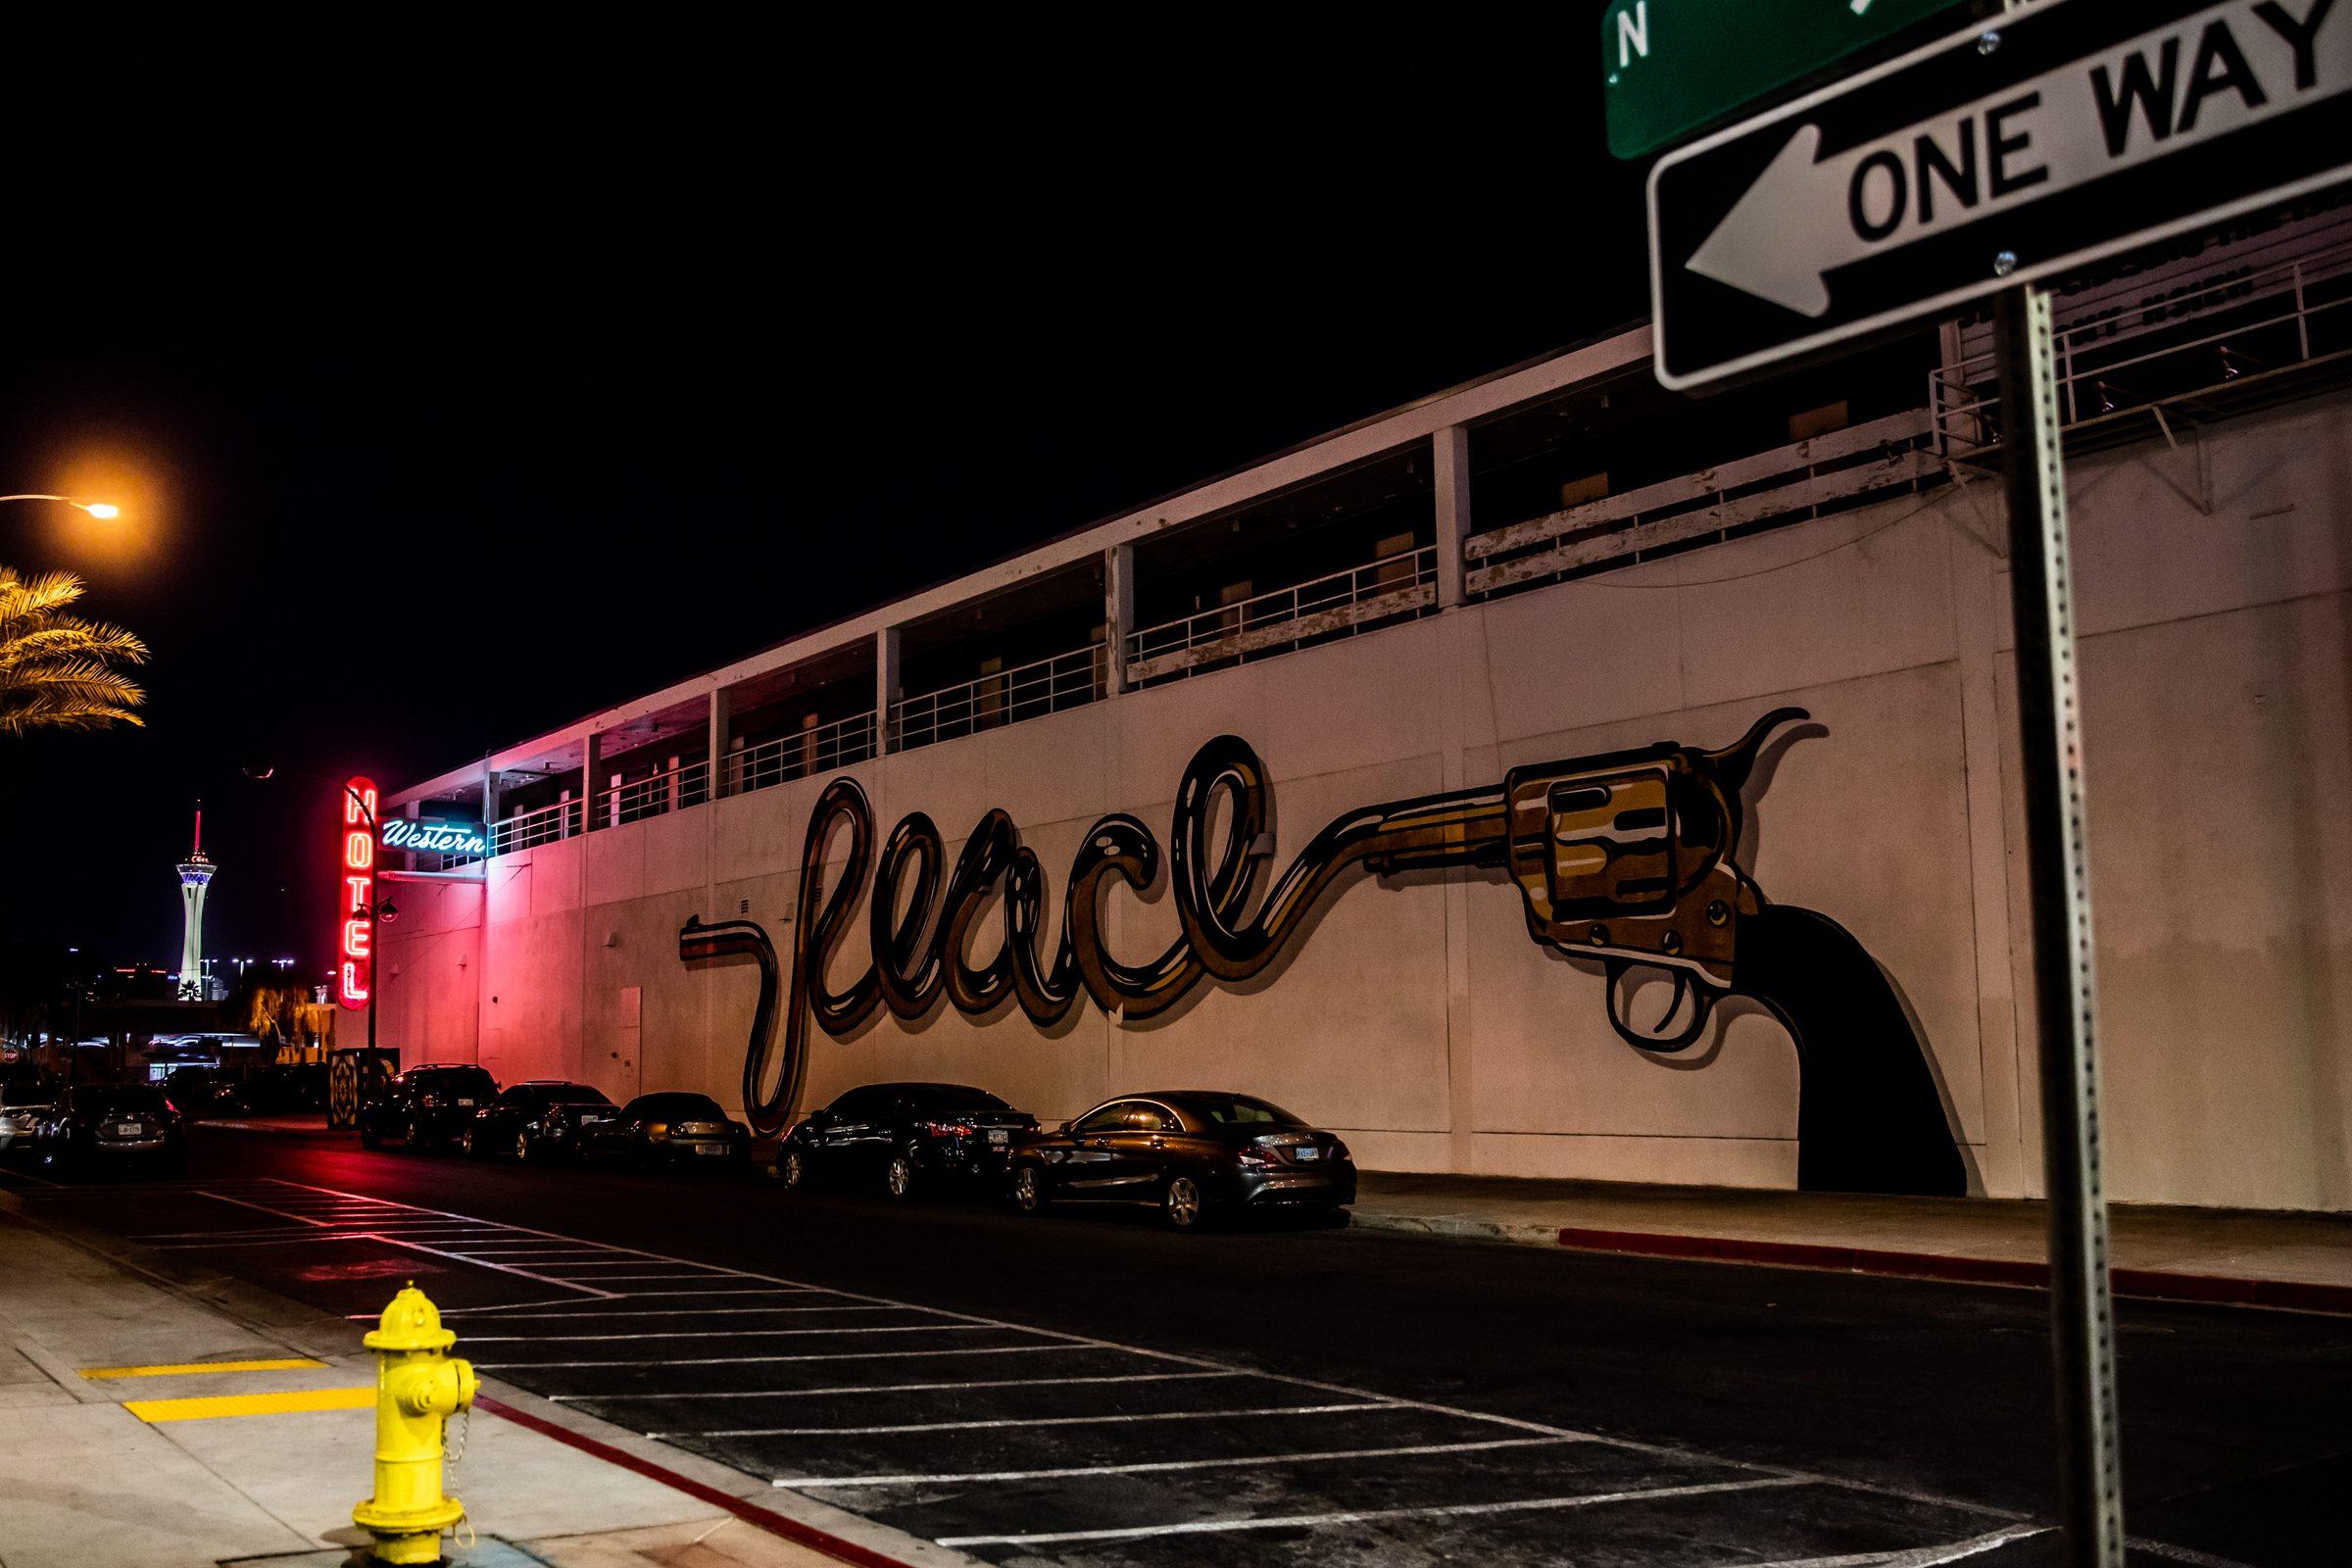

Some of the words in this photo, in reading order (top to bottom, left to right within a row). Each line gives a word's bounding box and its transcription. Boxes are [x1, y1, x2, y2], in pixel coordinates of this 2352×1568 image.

[1617, 0, 1649, 69] N
[1848, 91, 2049, 243] ONE
[2088, 0, 2332, 159] WAY
[345, 788, 375, 1000] HOTEL
[382, 819, 485, 854] Western
